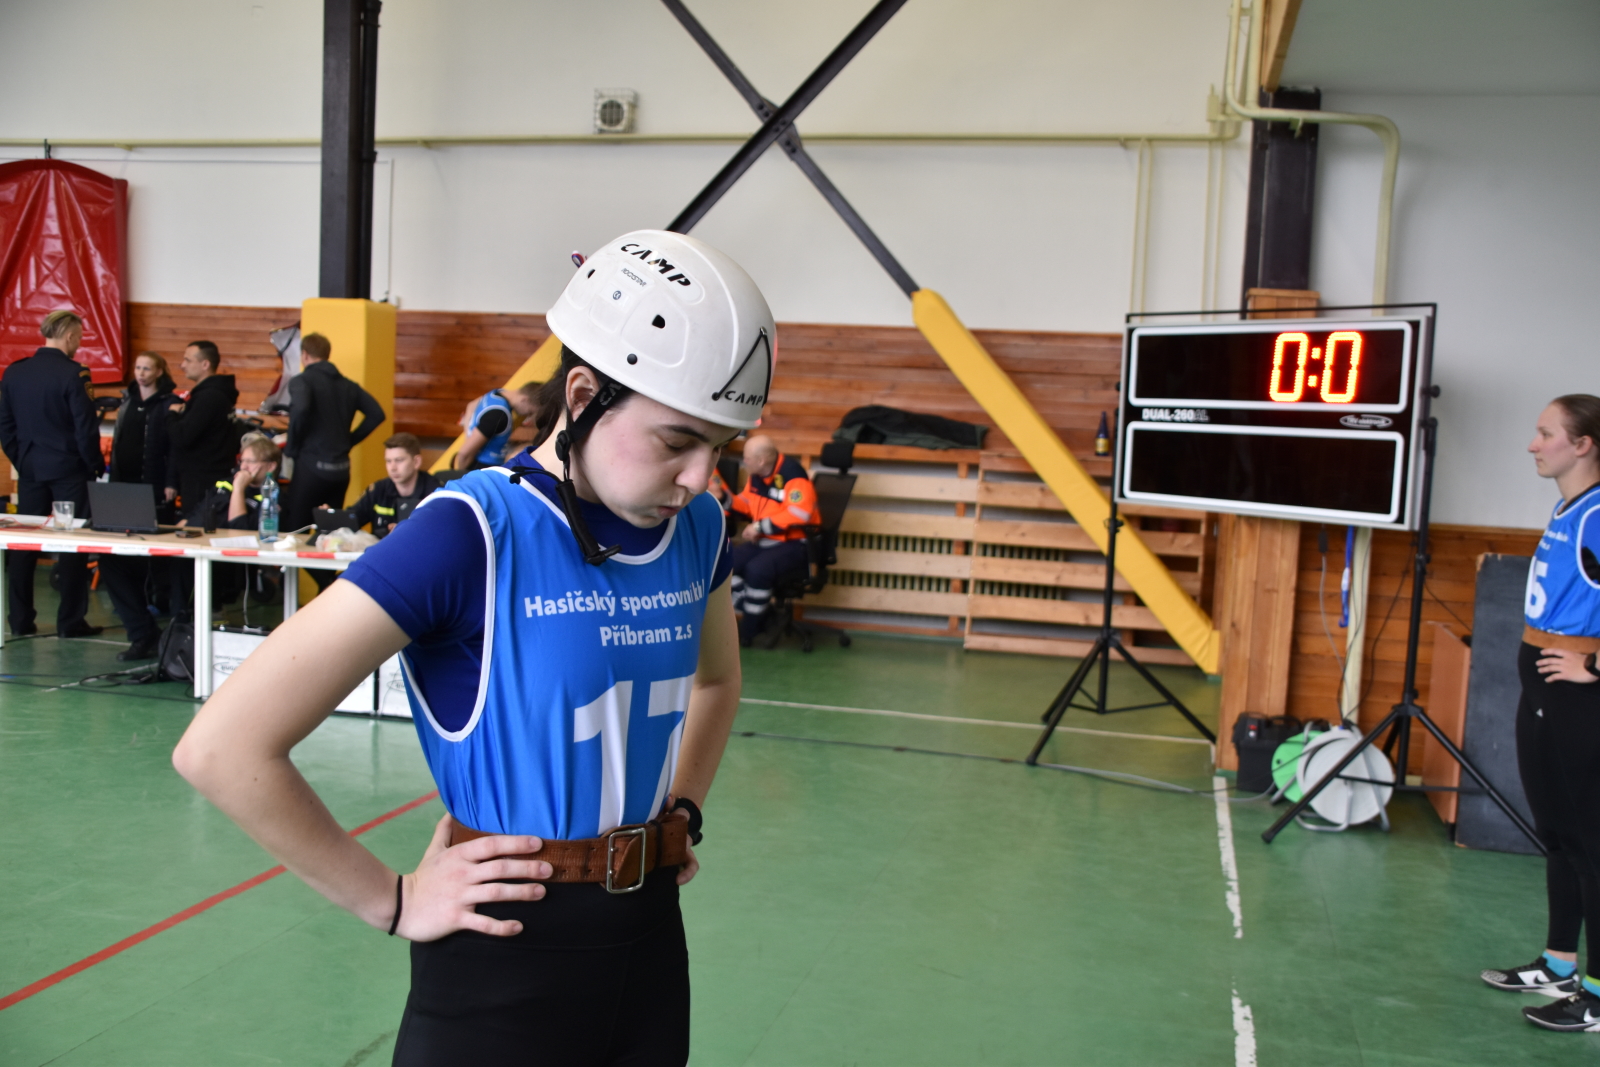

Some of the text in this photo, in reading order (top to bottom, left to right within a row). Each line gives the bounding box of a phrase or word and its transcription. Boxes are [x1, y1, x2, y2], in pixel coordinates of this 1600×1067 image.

[621, 243, 691, 288] CAMP
[1269, 331, 1362, 403] 0:0
[724, 391, 763, 406] CAMP
[524, 590, 616, 618] Hasičský
[600, 625, 671, 647] Příbram
[573, 673, 696, 836] 17
